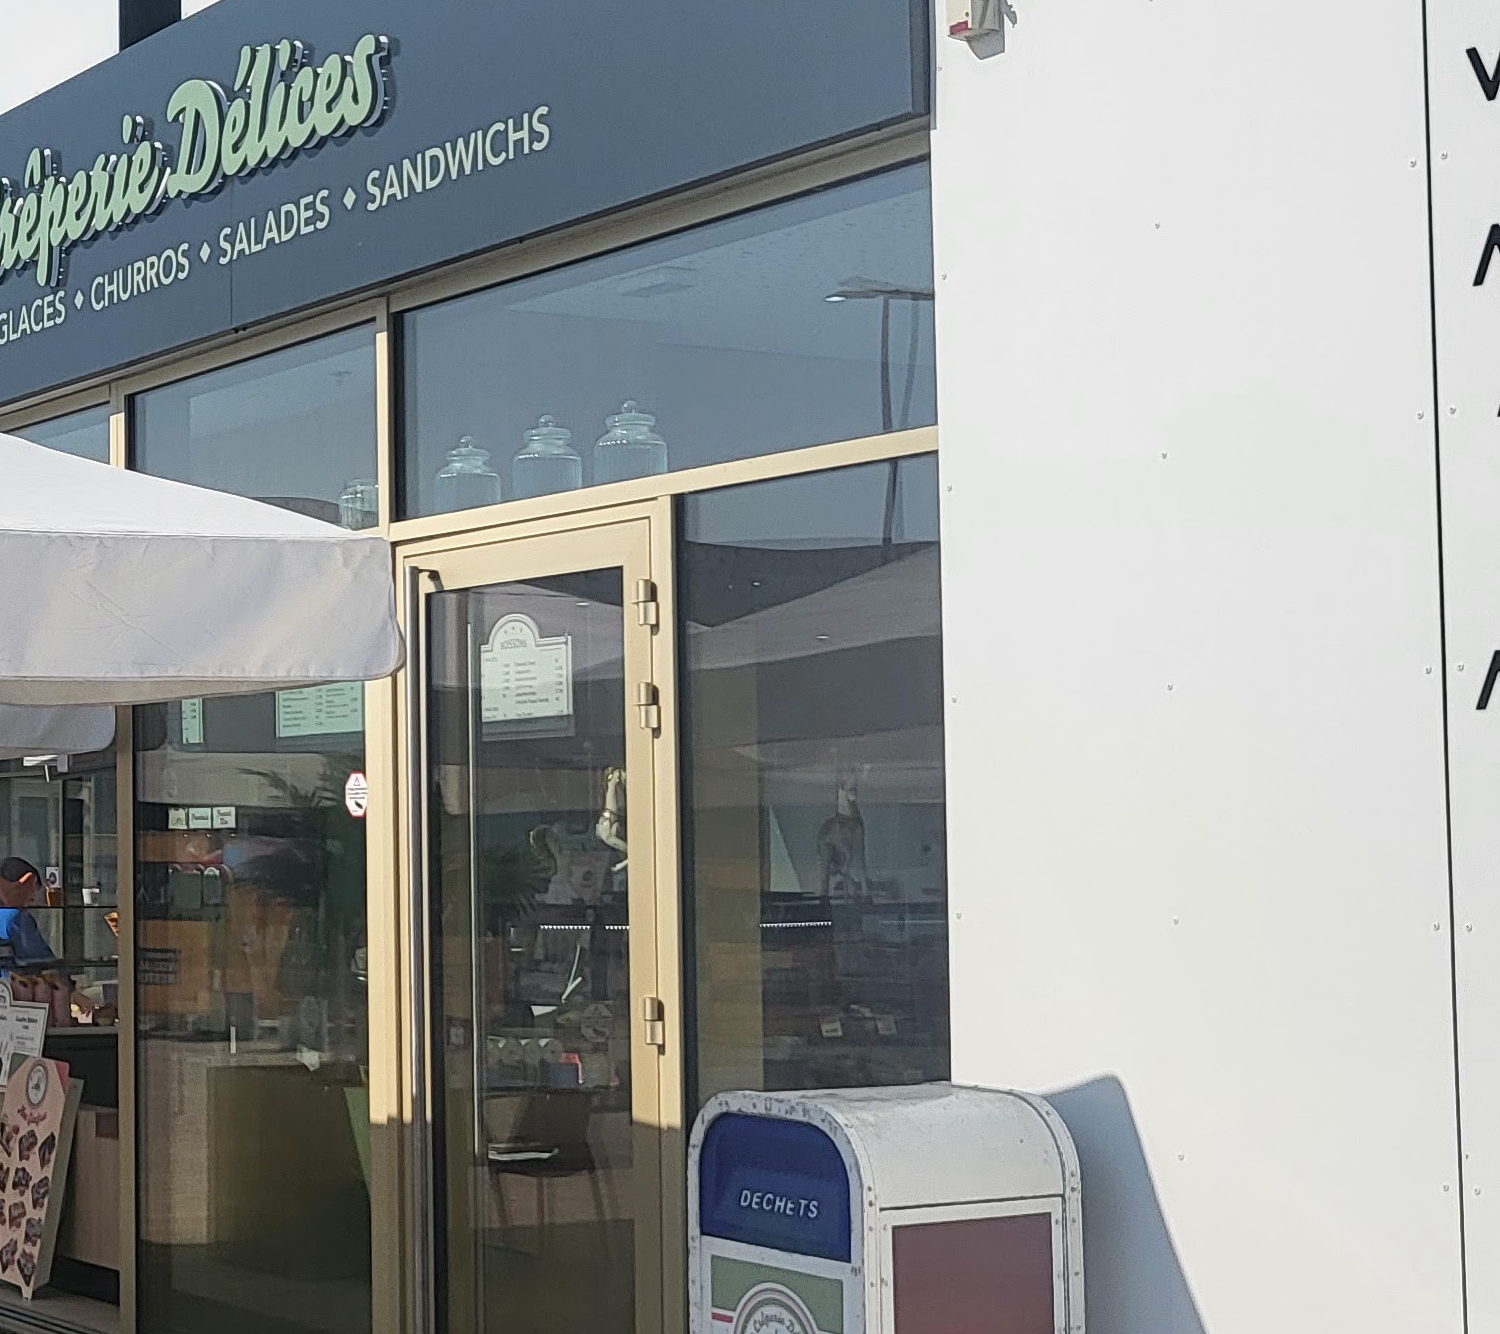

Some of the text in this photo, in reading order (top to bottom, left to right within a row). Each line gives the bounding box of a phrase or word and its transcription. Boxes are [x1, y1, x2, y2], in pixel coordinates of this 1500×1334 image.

[166, 34, 377, 197] Délices
[90, 244, 190, 312] CHURROS
[217, 188, 331, 265] SALADES
[365, 105, 550, 213] SANDWICHS
[740, 1189, 819, 1218] DECHETS
